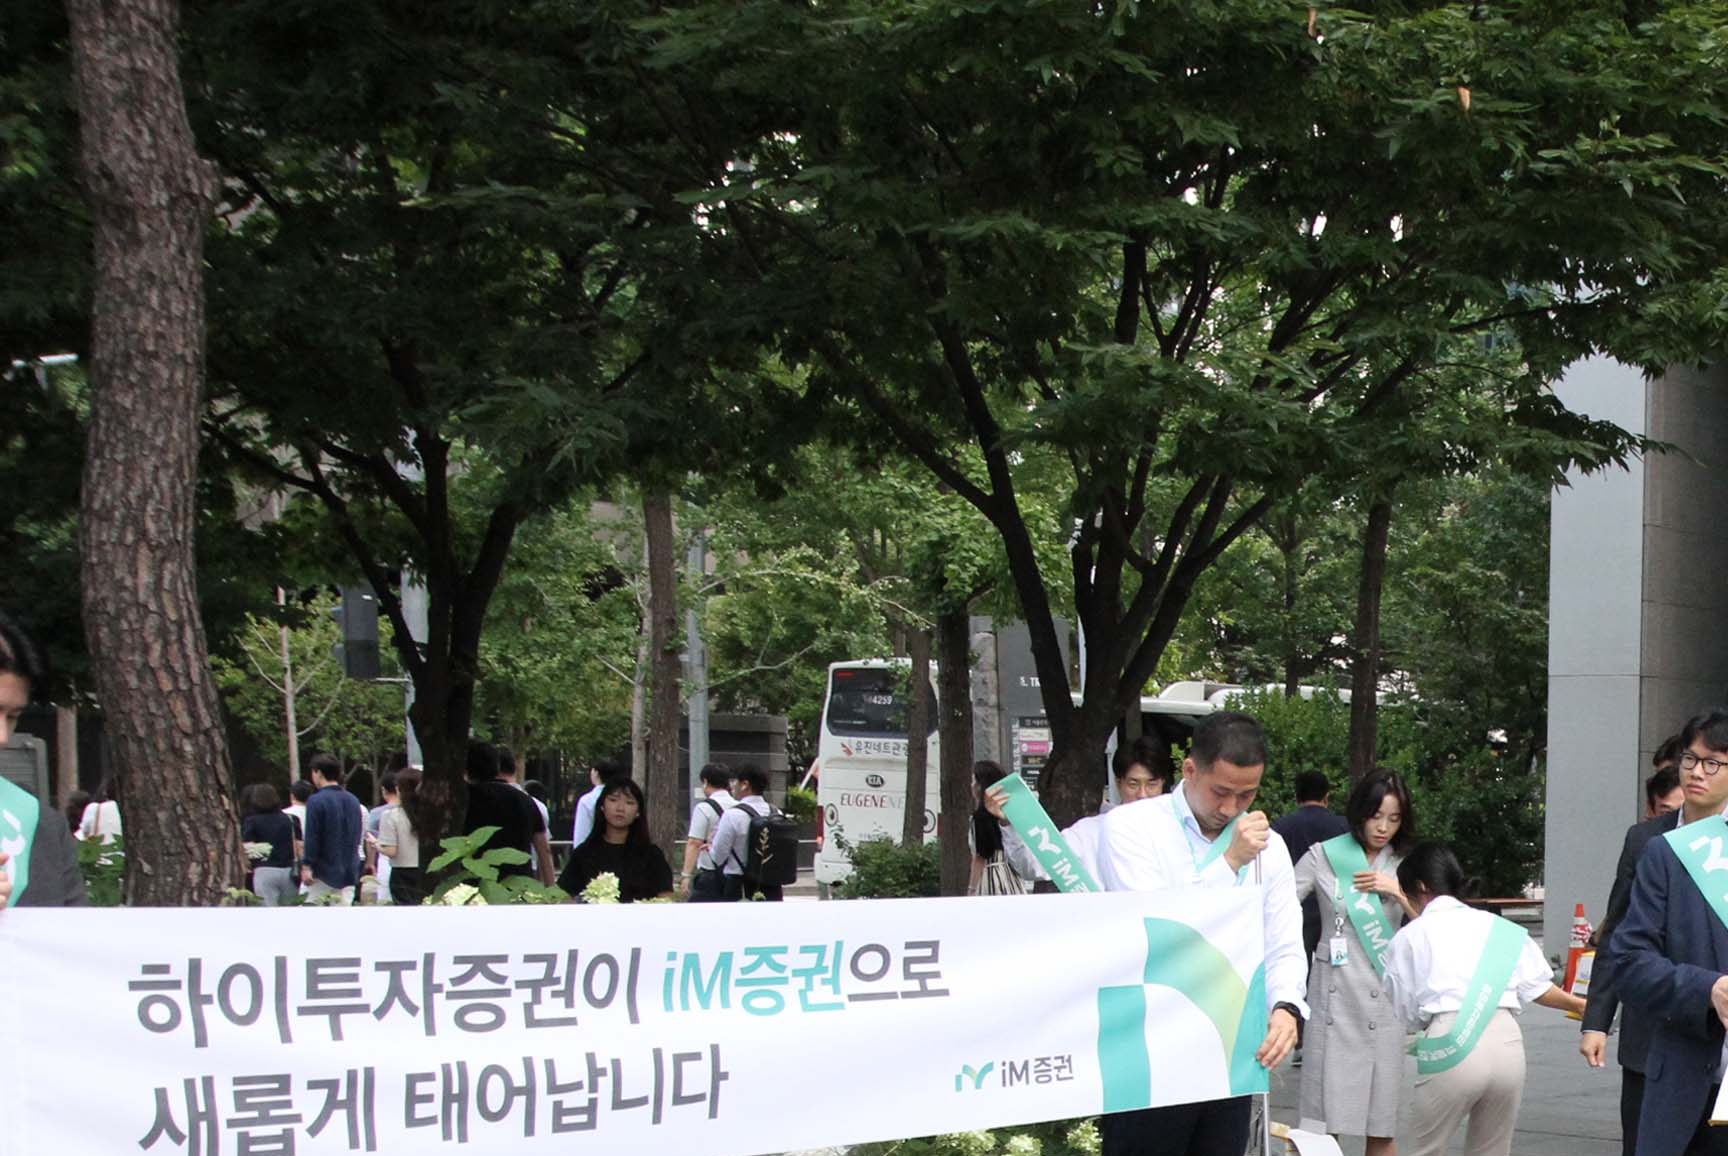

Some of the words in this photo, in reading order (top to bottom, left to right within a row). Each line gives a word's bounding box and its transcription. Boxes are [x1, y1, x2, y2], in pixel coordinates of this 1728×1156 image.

[867, 775, 882, 785] KIA
[127, 948, 642, 1049] 하이투자증권이
[662, 939, 950, 1017] iM증권으로
[404, 1043, 729, 1144] 태어납니다
